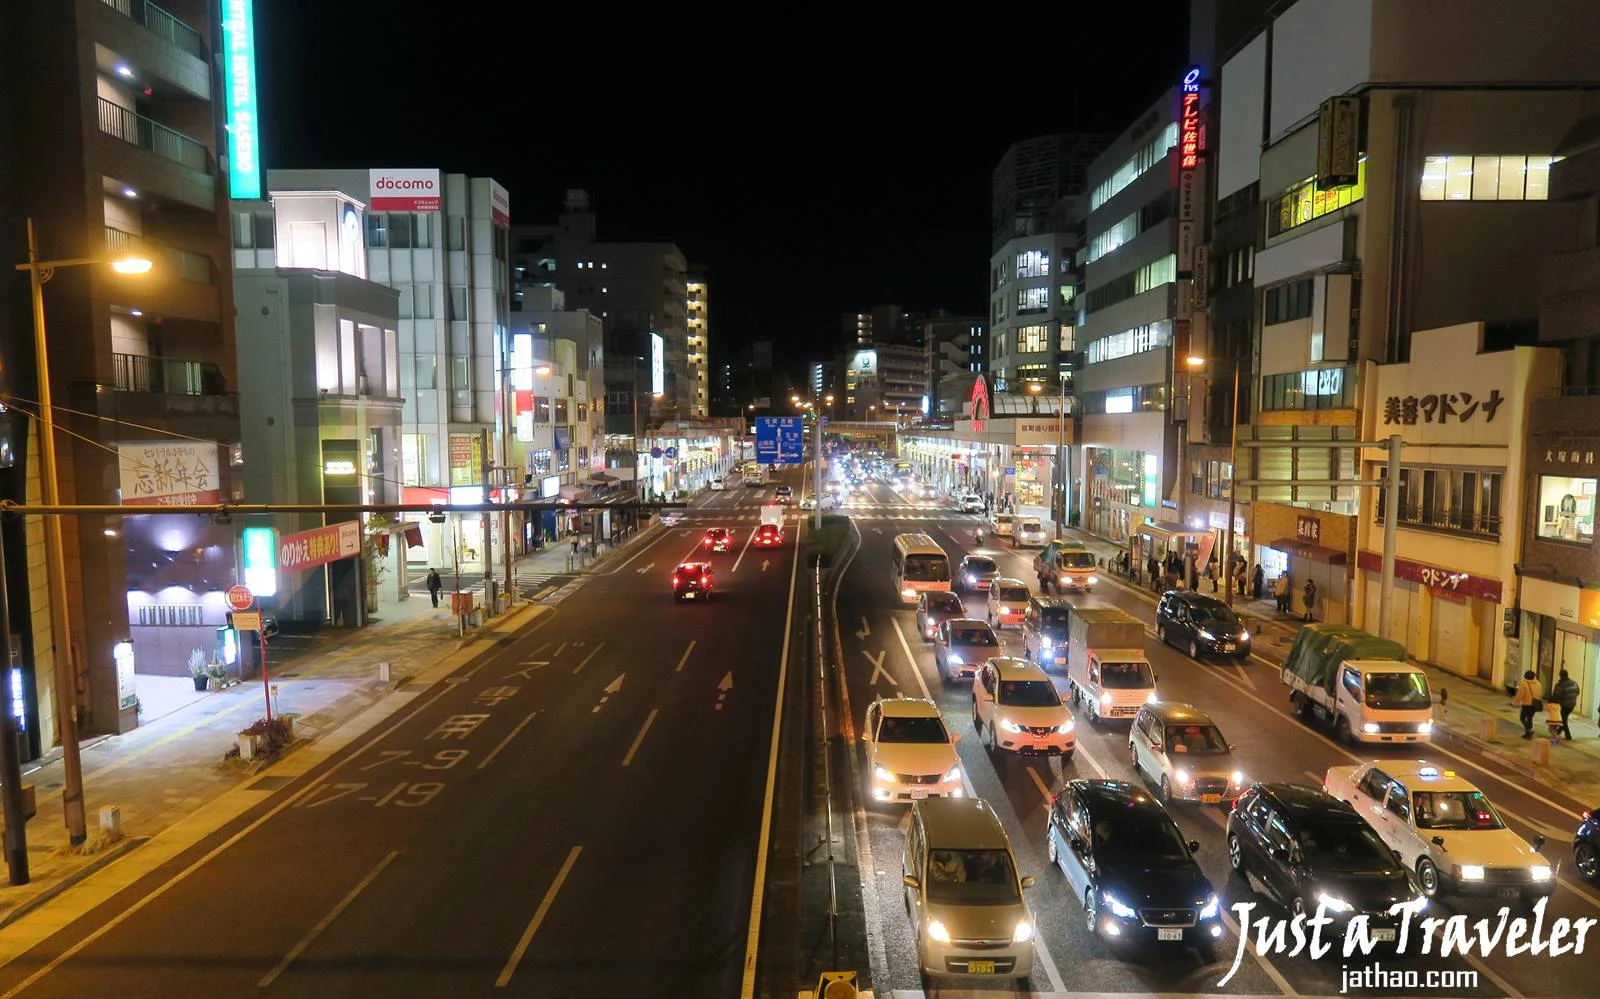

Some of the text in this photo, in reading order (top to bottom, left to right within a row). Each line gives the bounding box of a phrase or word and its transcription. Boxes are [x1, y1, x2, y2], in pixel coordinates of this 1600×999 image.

[233, 54, 249, 107] HOTEL
[1183, 84, 1199, 92] TVS
[235, 110, 253, 173] SASEBO
[1182, 93, 1199, 168] テレビ佐世保
[376, 176, 434, 190] docomo
[1383, 389, 1505, 426] 美容マドンナ
[1421, 567, 1469, 591] マドンナ
[359, 749, 468, 771] 7-9
[292, 781, 446, 808] 17-19
